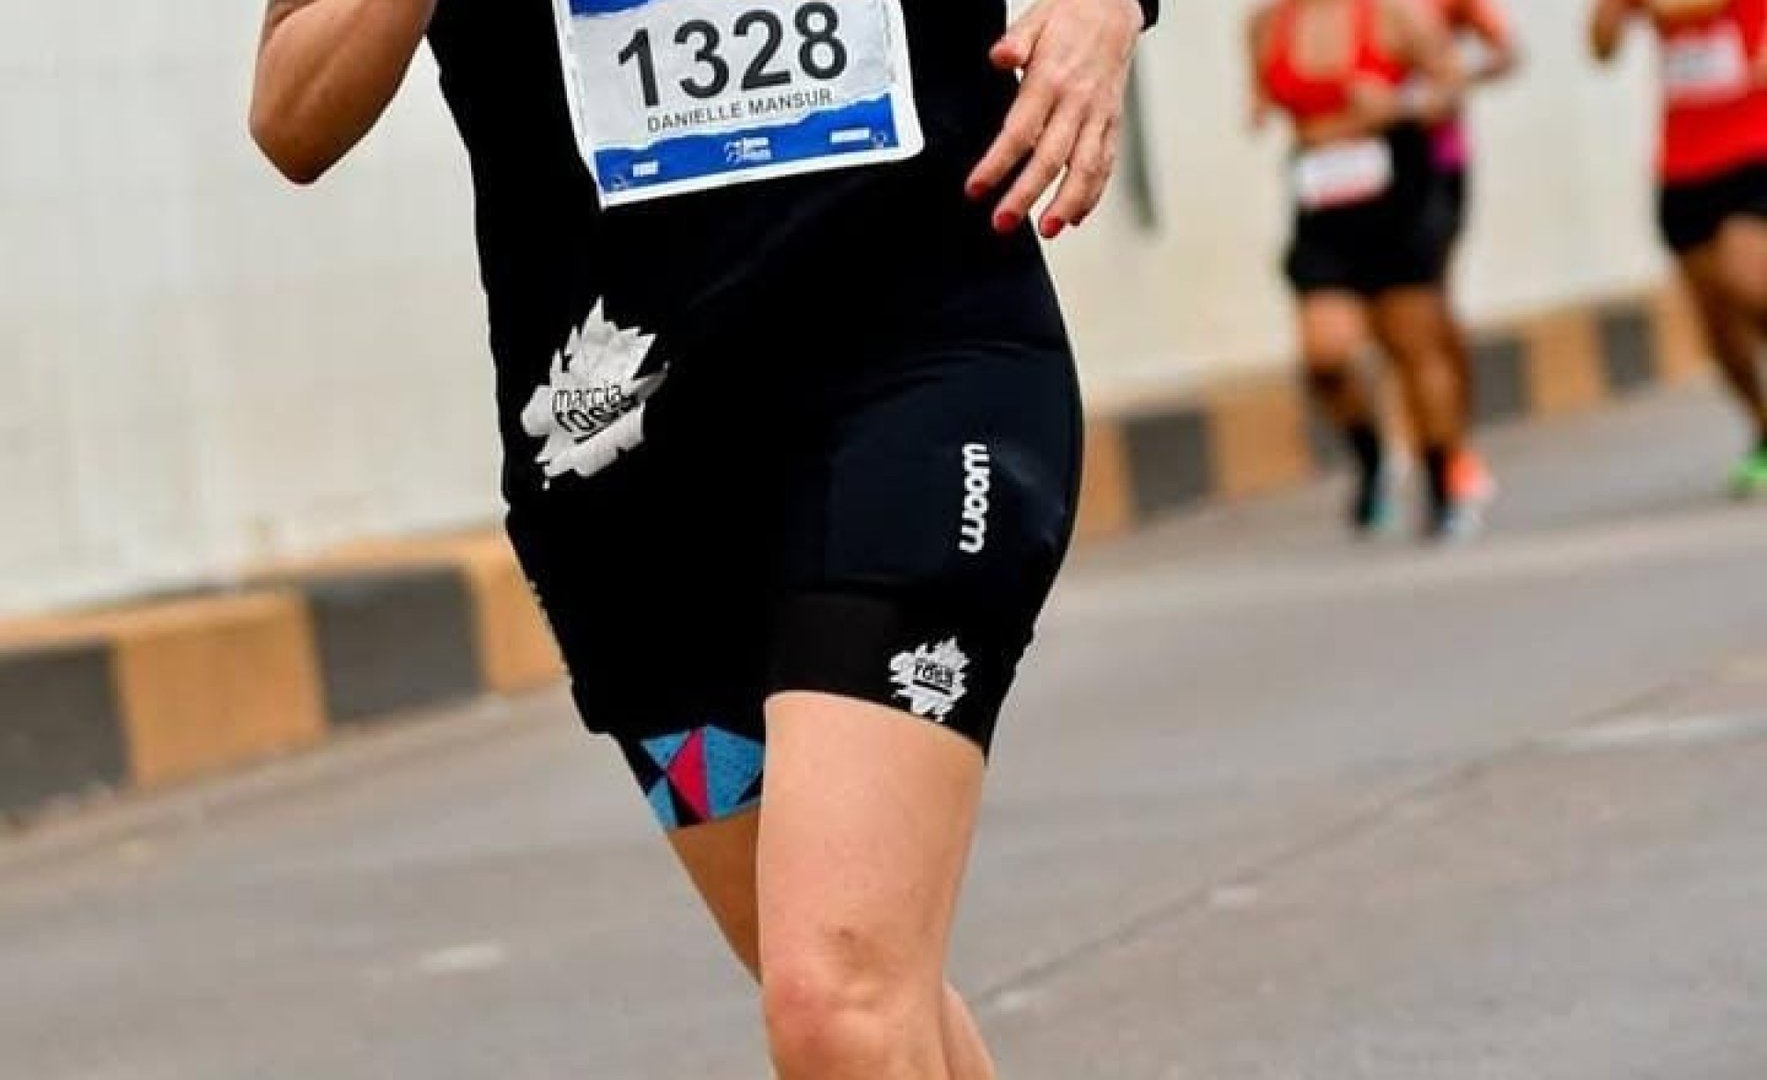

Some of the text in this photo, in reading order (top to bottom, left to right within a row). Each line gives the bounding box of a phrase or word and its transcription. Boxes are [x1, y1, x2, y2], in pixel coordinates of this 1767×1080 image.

[617, 1, 847, 108] 1328
[647, 87, 833, 133] DANIELLE MANSUR
[959, 443, 990, 553] woom
